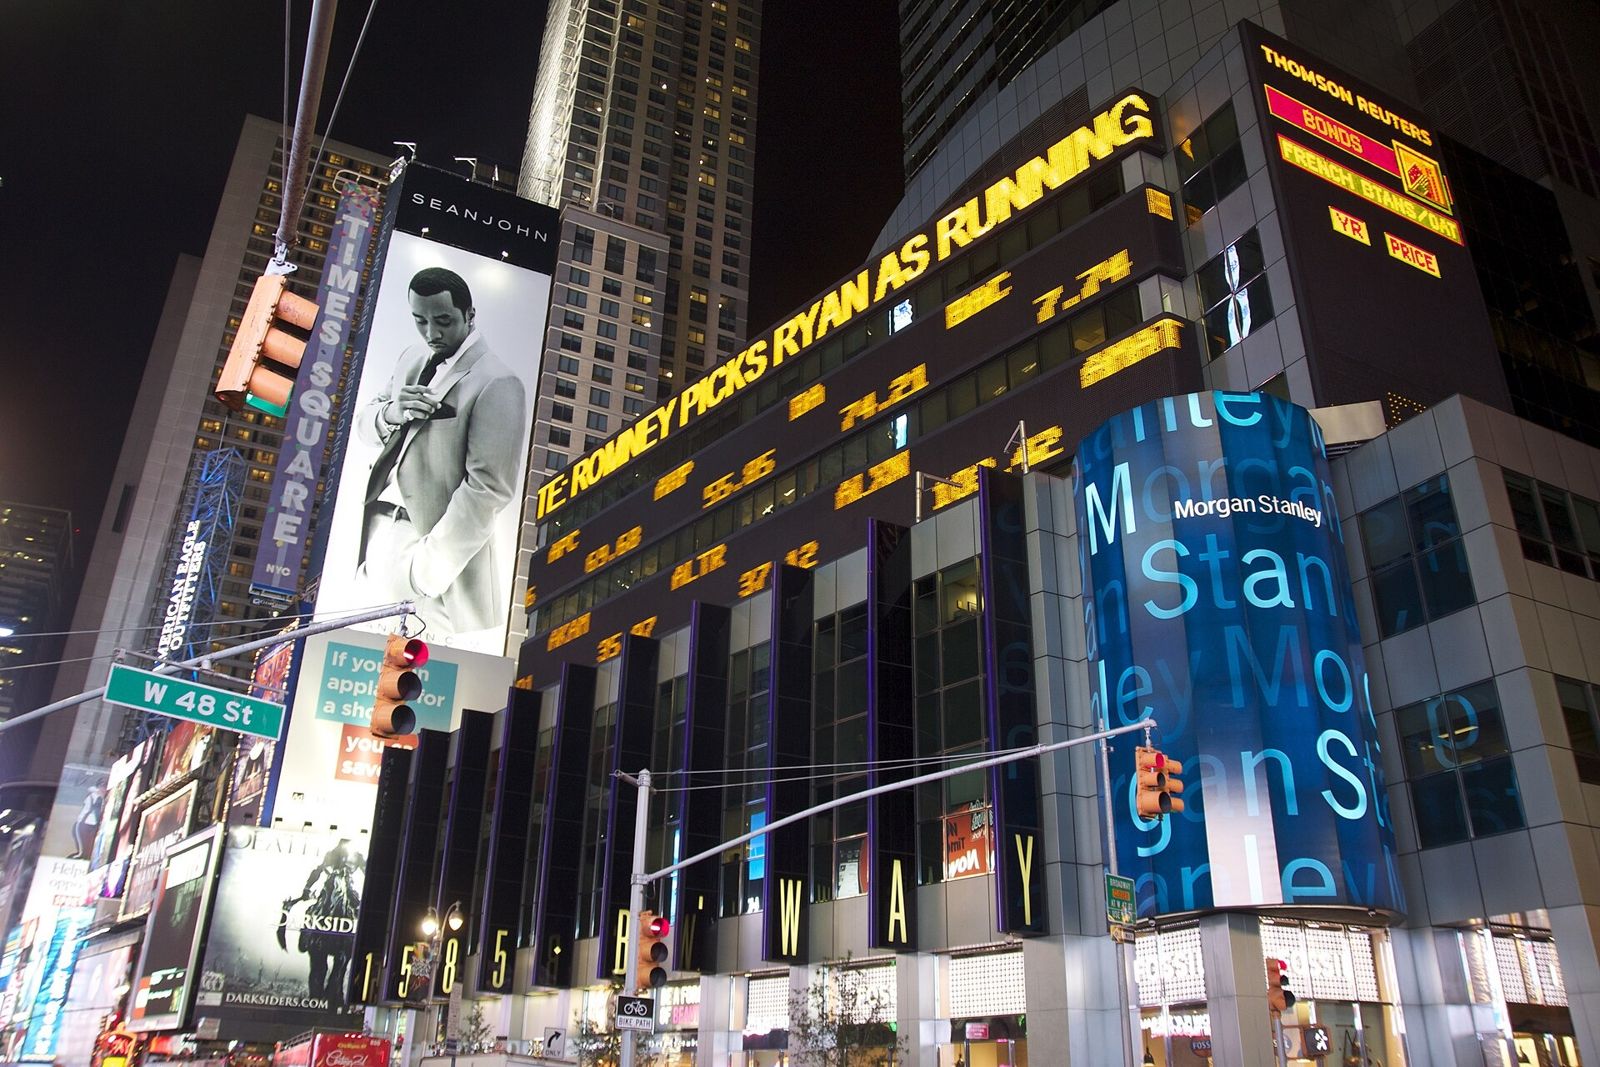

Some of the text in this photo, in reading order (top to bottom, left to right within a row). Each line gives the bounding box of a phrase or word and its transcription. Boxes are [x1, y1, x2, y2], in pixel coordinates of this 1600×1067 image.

[1261, 45, 1432, 147] THOMSON REUTERS
[1302, 108, 1363, 153] BONDS
[1283, 142, 1355, 191] FRENCH
[1335, 211, 1436, 273] YR PRICE
[570, 397, 677, 498] ROMNEY
[679, 340, 768, 427] PICKS
[774, 269, 869, 367] RYAN
[873, 234, 930, 302] AS
[936, 94, 1153, 261] RUNNING
[273, 213, 369, 544] TIMES SQUARE
[1174, 495, 1322, 528] Morgan Stanley
[177, 519, 200, 577] EAGLE
[265, 563, 291, 577] NYC
[170, 541, 206, 651] OUTFITTERS
[331, 651, 348, 667] If
[144, 681, 253, 725] W 48 St
[323, 701, 335, 714] a
[345, 736, 384, 753] you
[226, 991, 329, 1010] DARKSIDERS.COM
[619, 1016, 651, 1028] BIKE PATH
